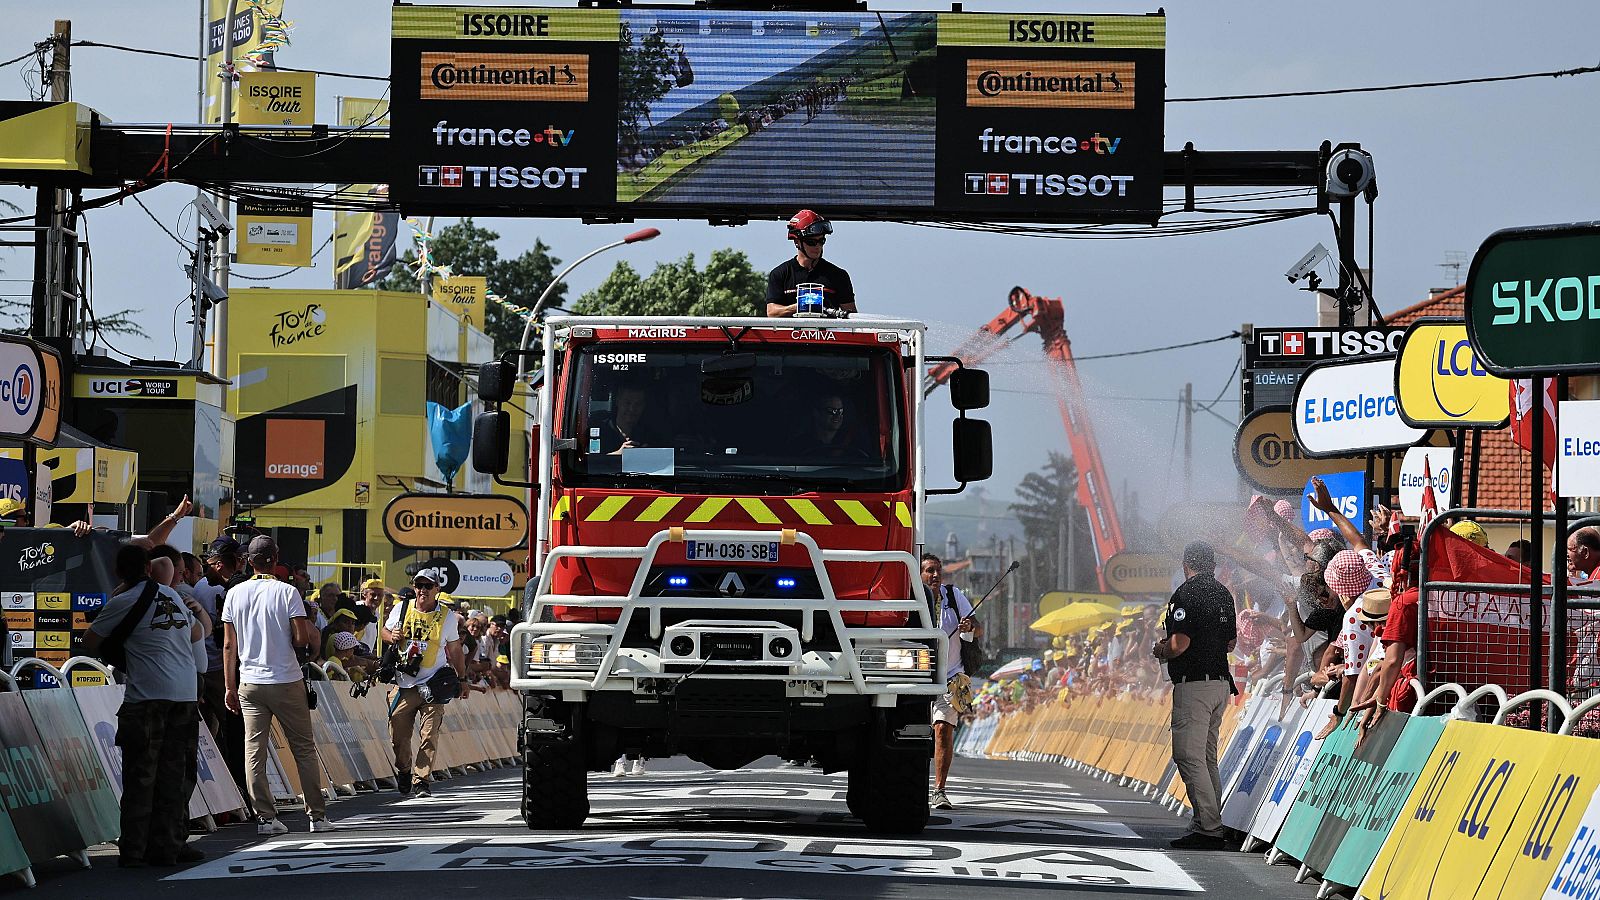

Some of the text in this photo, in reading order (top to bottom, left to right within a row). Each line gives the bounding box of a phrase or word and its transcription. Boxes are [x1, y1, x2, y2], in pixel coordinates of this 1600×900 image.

[232, 27, 251, 41] ADIO
[463, 14, 549, 37] ISSOIRE
[1008, 20, 1095, 43] ISSOIRE
[431, 62, 556, 89] Continental
[977, 70, 1103, 97] Continental
[249, 86, 301, 98] ISSOIRE
[267, 97, 301, 113] Tour
[466, 166, 588, 189] TISSOT
[1012, 174, 1134, 197] TISSOT
[440, 285, 476, 294] ISSOIRE
[452, 292, 475, 304] Tour
[628, 328, 687, 338] MAGIRUS
[791, 330, 836, 341] CAMIVA
[1308, 331, 1406, 355] TISSO
[593, 353, 647, 365] ISSOIRE
[1437, 339, 1487, 376] LCL
[92, 382, 121, 393] UCI
[1255, 371, 1294, 385] 10ÈME
[1304, 394, 1396, 424] E.Leclerc
[268, 463, 319, 477] orange
[394, 509, 501, 532] Continental
[696, 543, 768, 559] FM-036-SB
[77, 596, 102, 607] Krys
[1414, 751, 1460, 822] LCL
[1458, 758, 1516, 840] LCL
[1523, 774, 1580, 861] LCL
[244, 837, 1154, 872] SKODA
